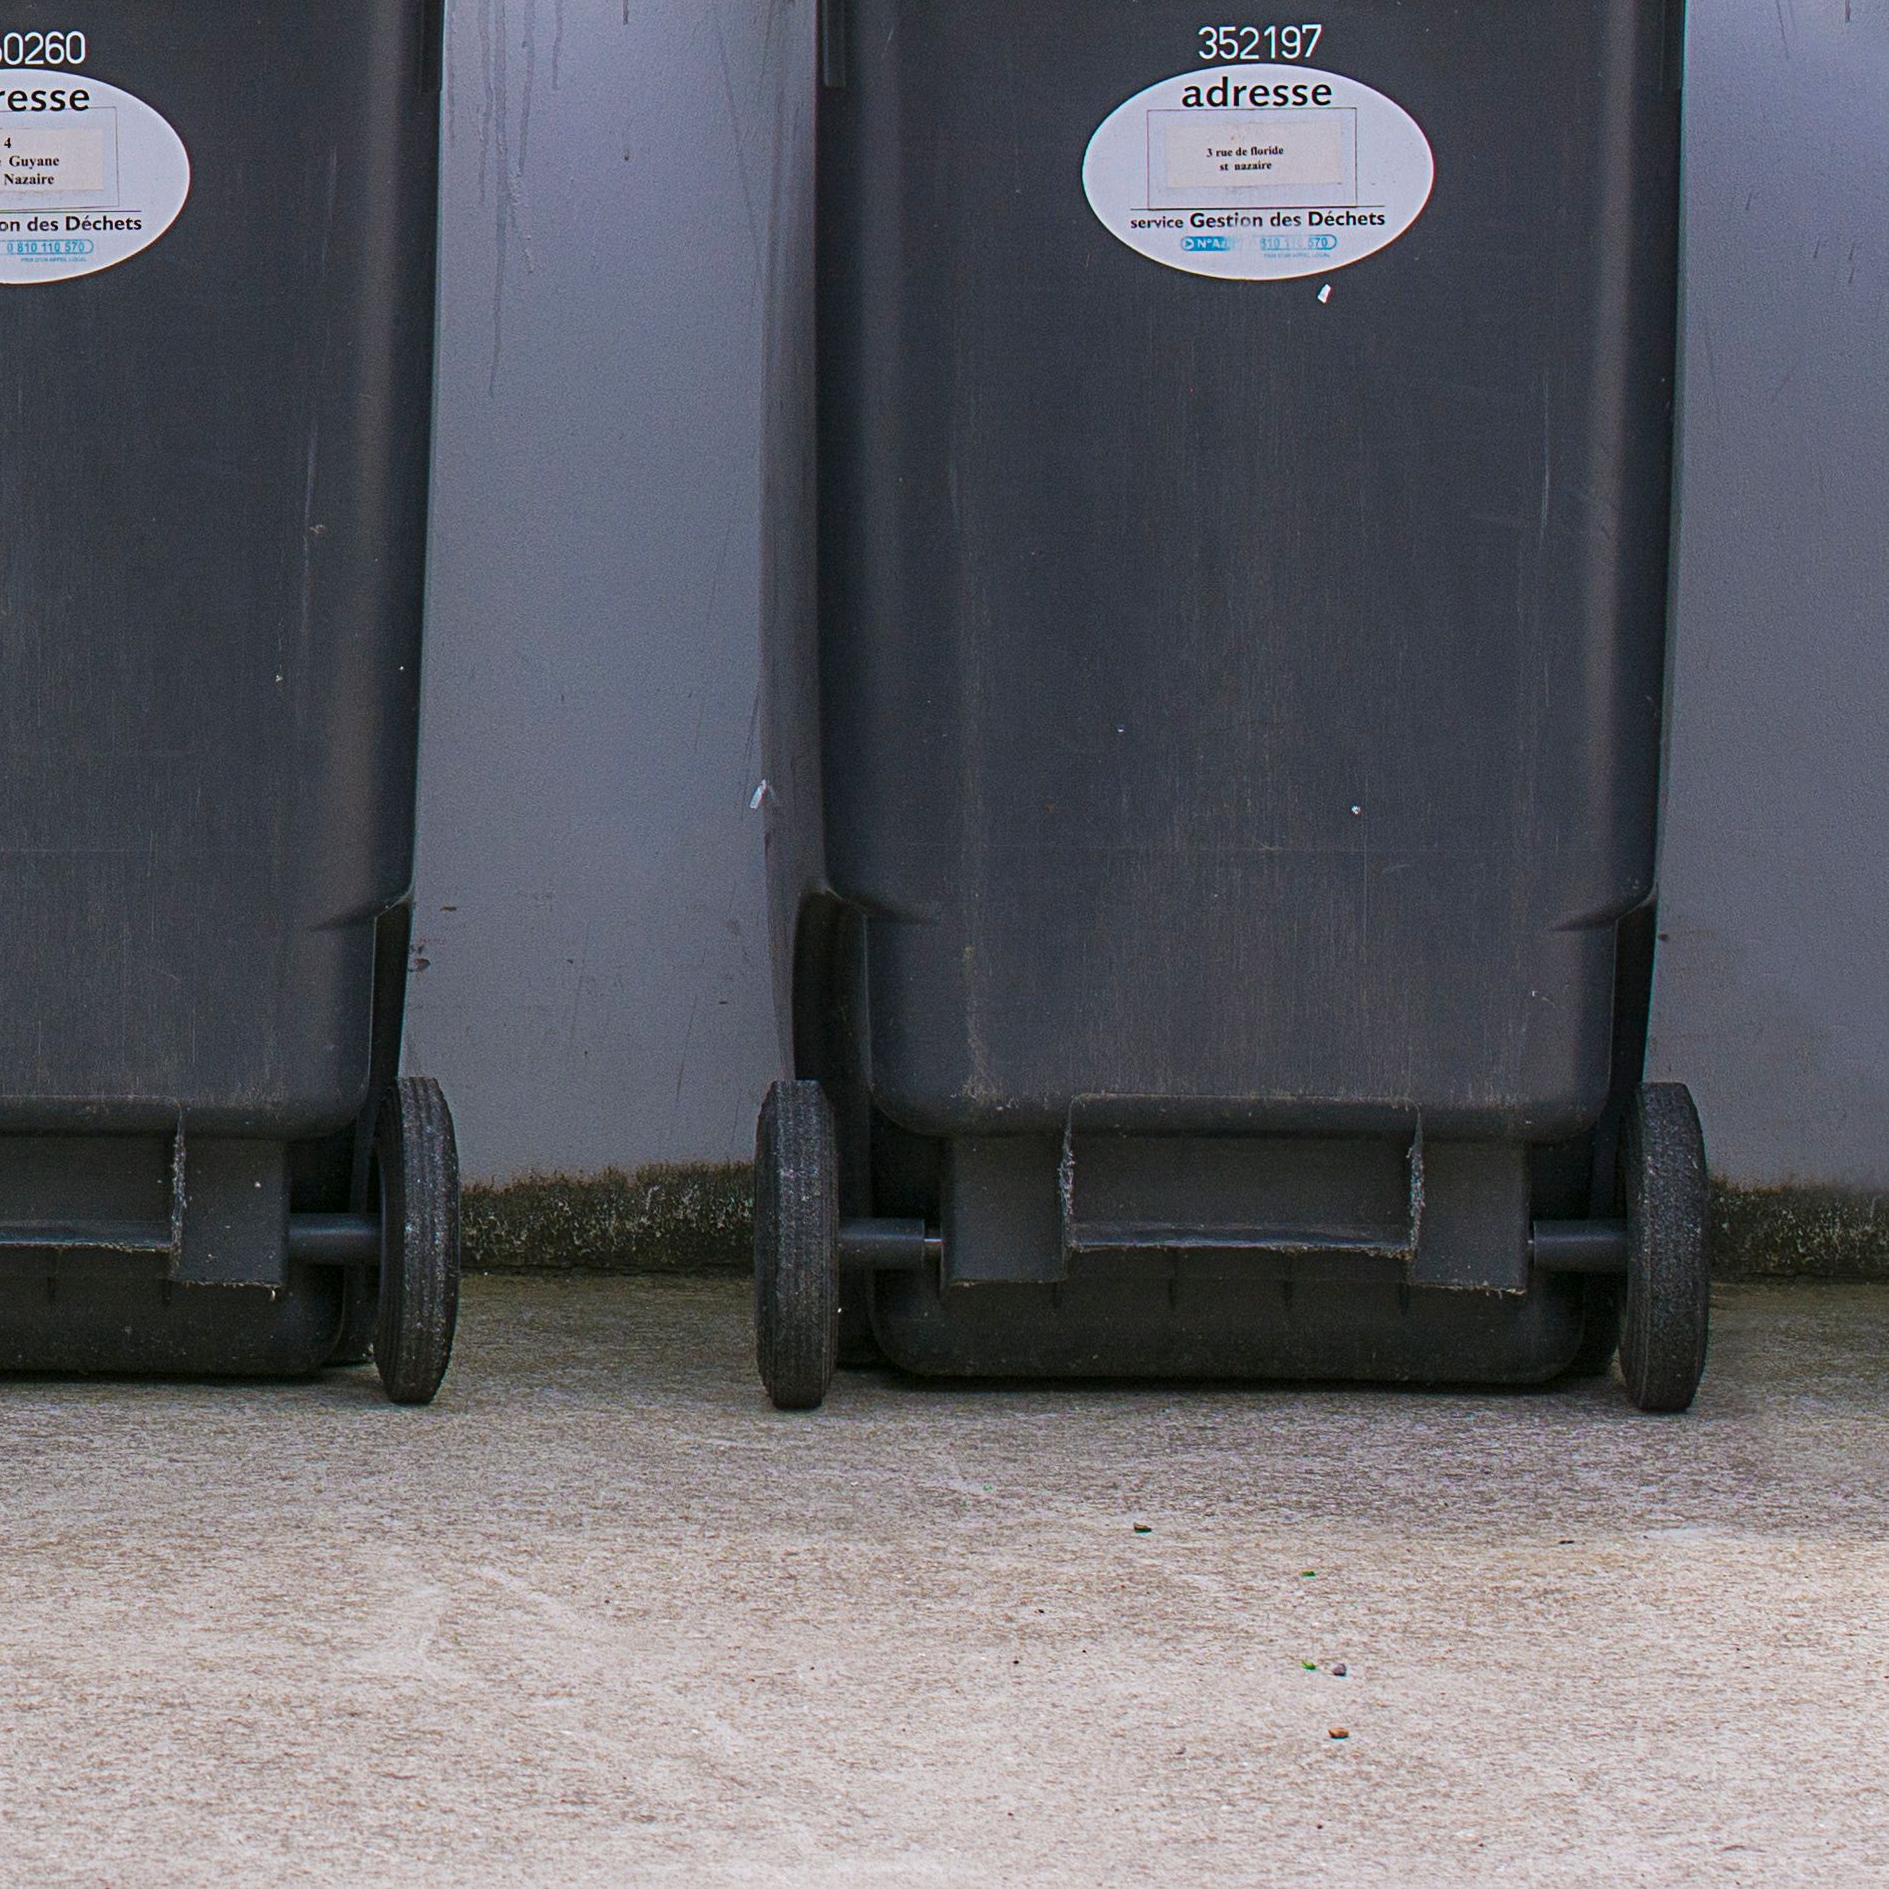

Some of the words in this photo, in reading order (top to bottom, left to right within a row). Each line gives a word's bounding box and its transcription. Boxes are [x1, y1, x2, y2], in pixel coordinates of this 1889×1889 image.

[1198, 24, 1322, 59] 352197
[1182, 76, 1332, 108] adresse
[4, 137, 12, 149] 4
[1207, 148, 1213, 157] 3
[1235, 147, 1248, 157] de
[1250, 146, 1284, 157] floride
[9, 156, 60, 171] Guyane
[1220, 162, 1229, 172] st
[1234, 161, 1272, 171] nazaire
[3, 173, 55, 186] Nazaire
[27, 215, 59, 232] des
[65, 215, 142, 232] Déchets
[1130, 216, 1183, 229] service
[1190, 212, 1263, 229] Gestion
[1270, 211, 1302, 227] des
[1308, 211, 1385, 227] Déchets
[17, 241, 38, 253] 810
[41, 241, 61, 253] 110
[65, 241, 85, 253] 570
